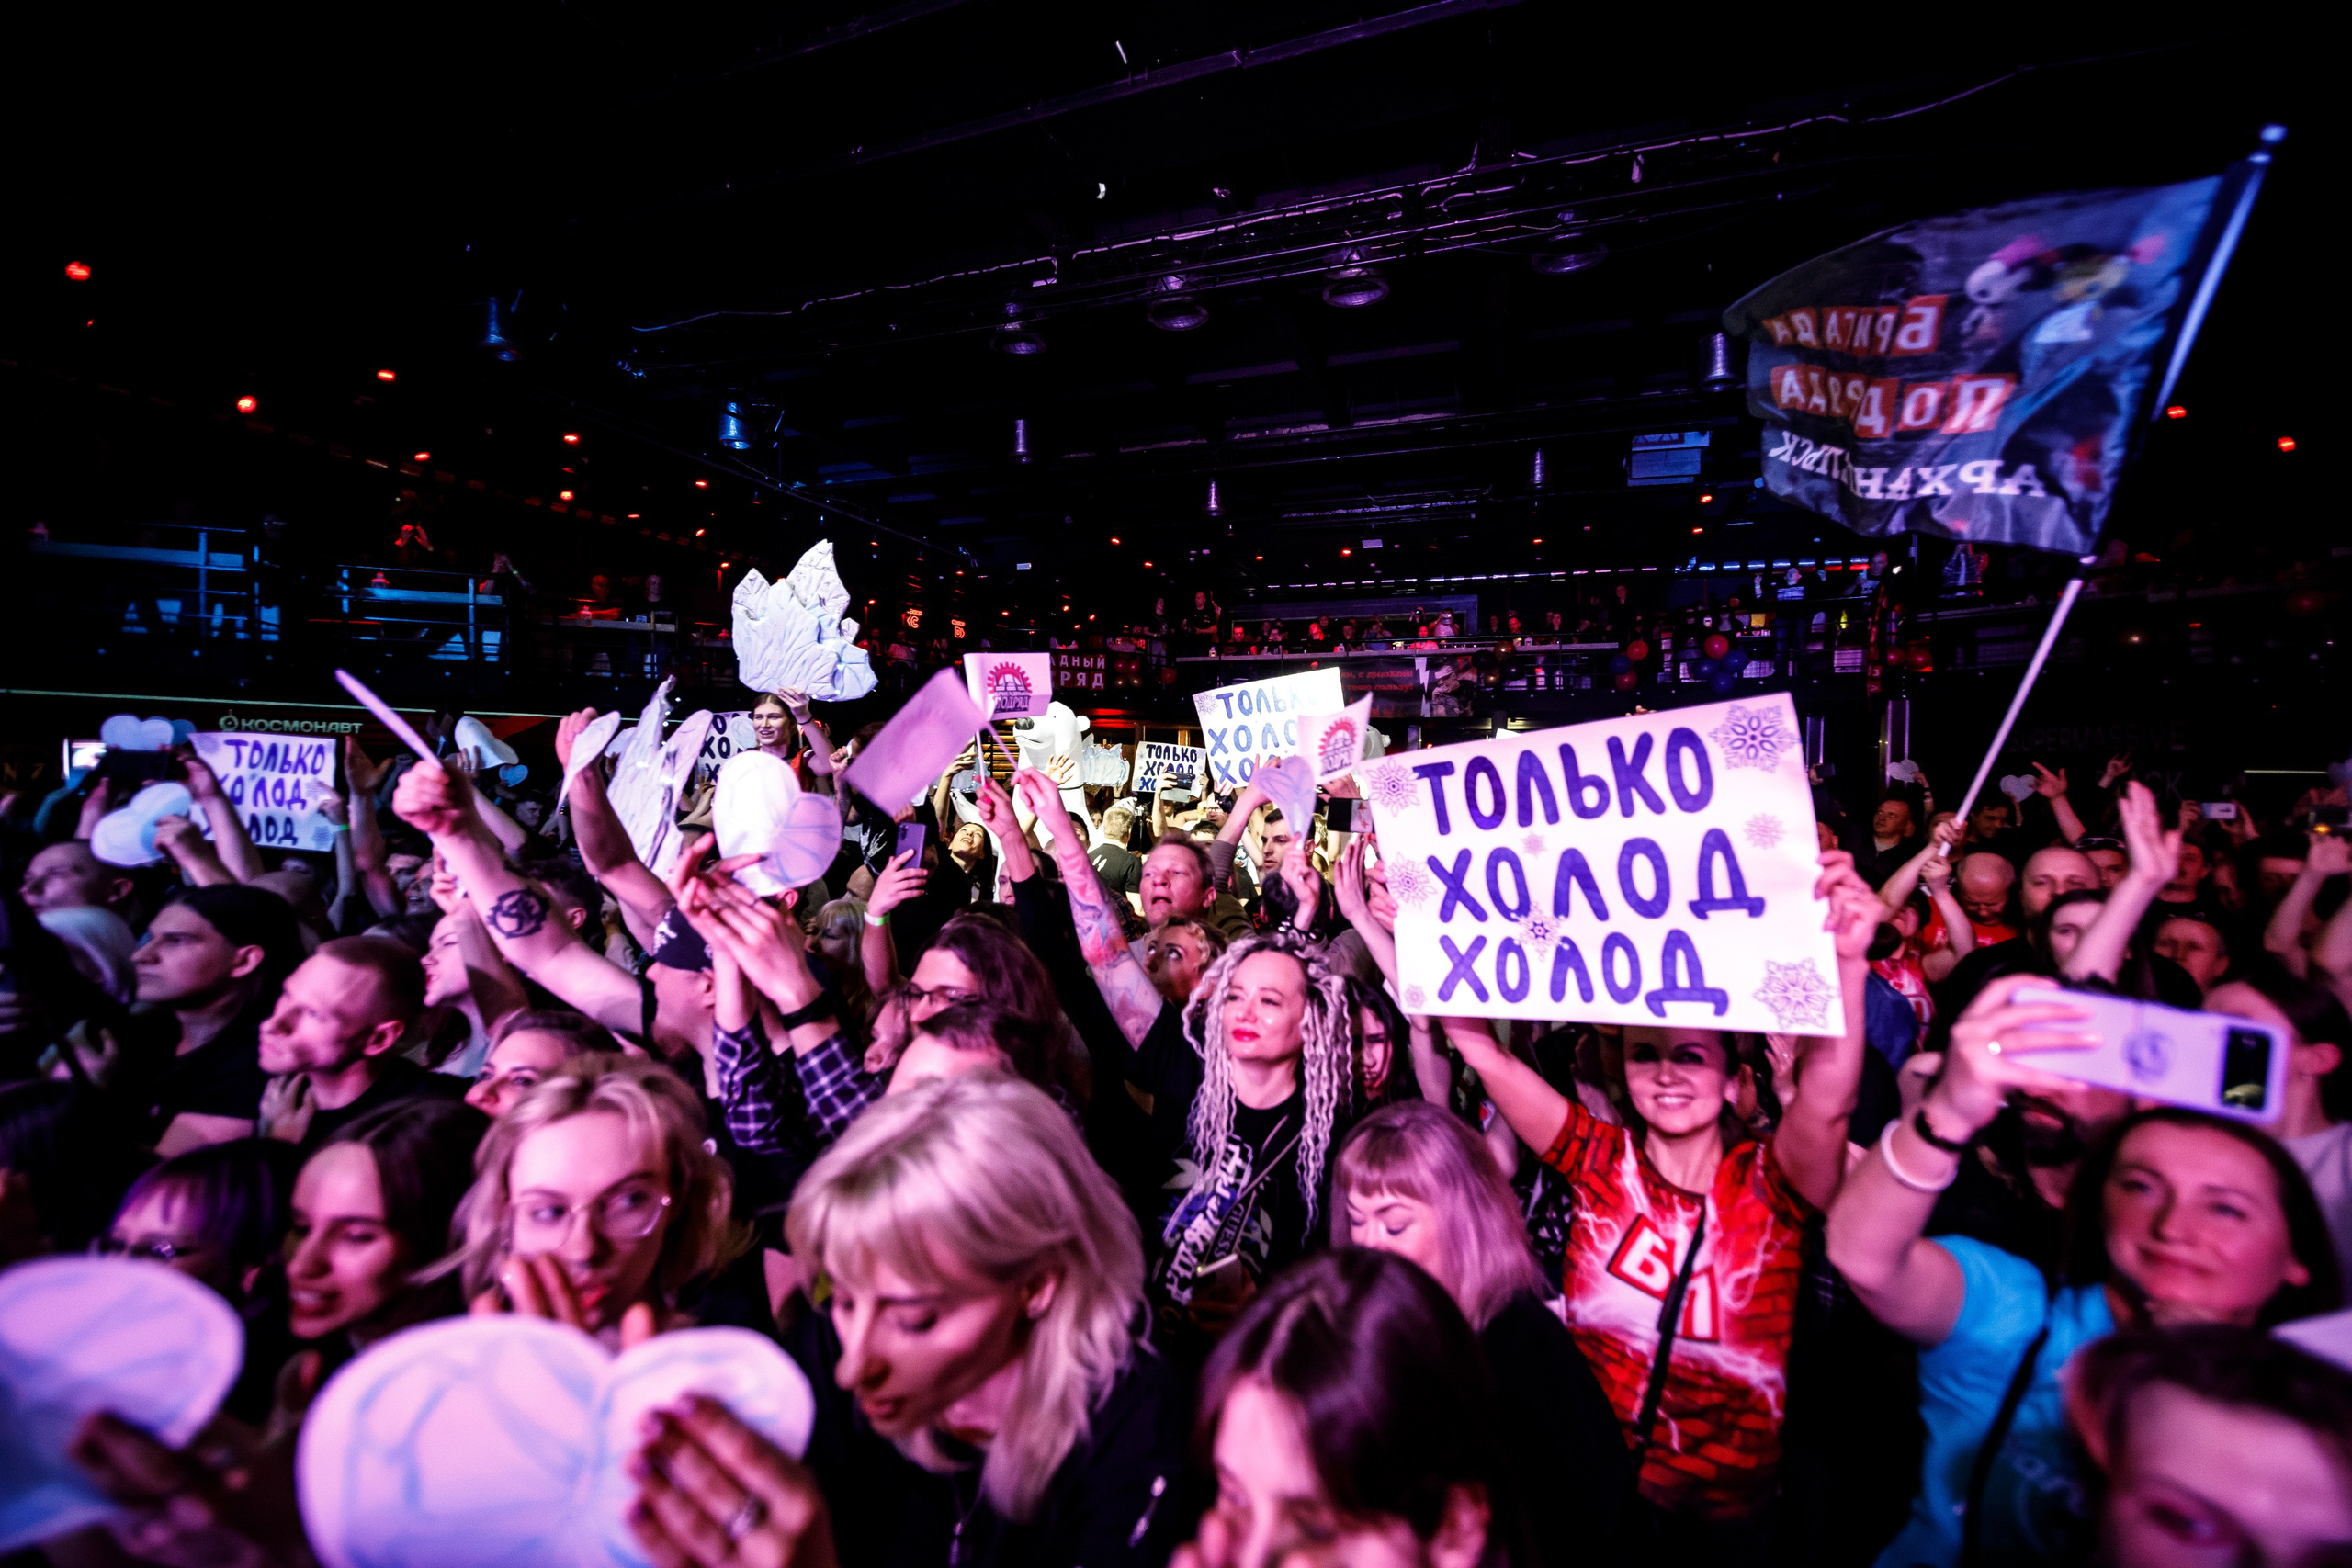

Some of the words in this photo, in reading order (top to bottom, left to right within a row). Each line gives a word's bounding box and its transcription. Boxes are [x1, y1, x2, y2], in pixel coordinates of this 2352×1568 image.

[1059, 671, 1104, 690] РЯД
[1146, 744, 1197, 763] ТОЛЬКО
[1208, 719, 1297, 757] ХОЛО
[224, 739, 325, 775] ТОЛЬКО
[1412, 727, 1713, 835] ТОЛЬКО
[248, 813, 298, 845] ЛОД
[1427, 828, 1765, 922] ХОЛОД
[1438, 929, 1729, 1018] ХОЛОД
